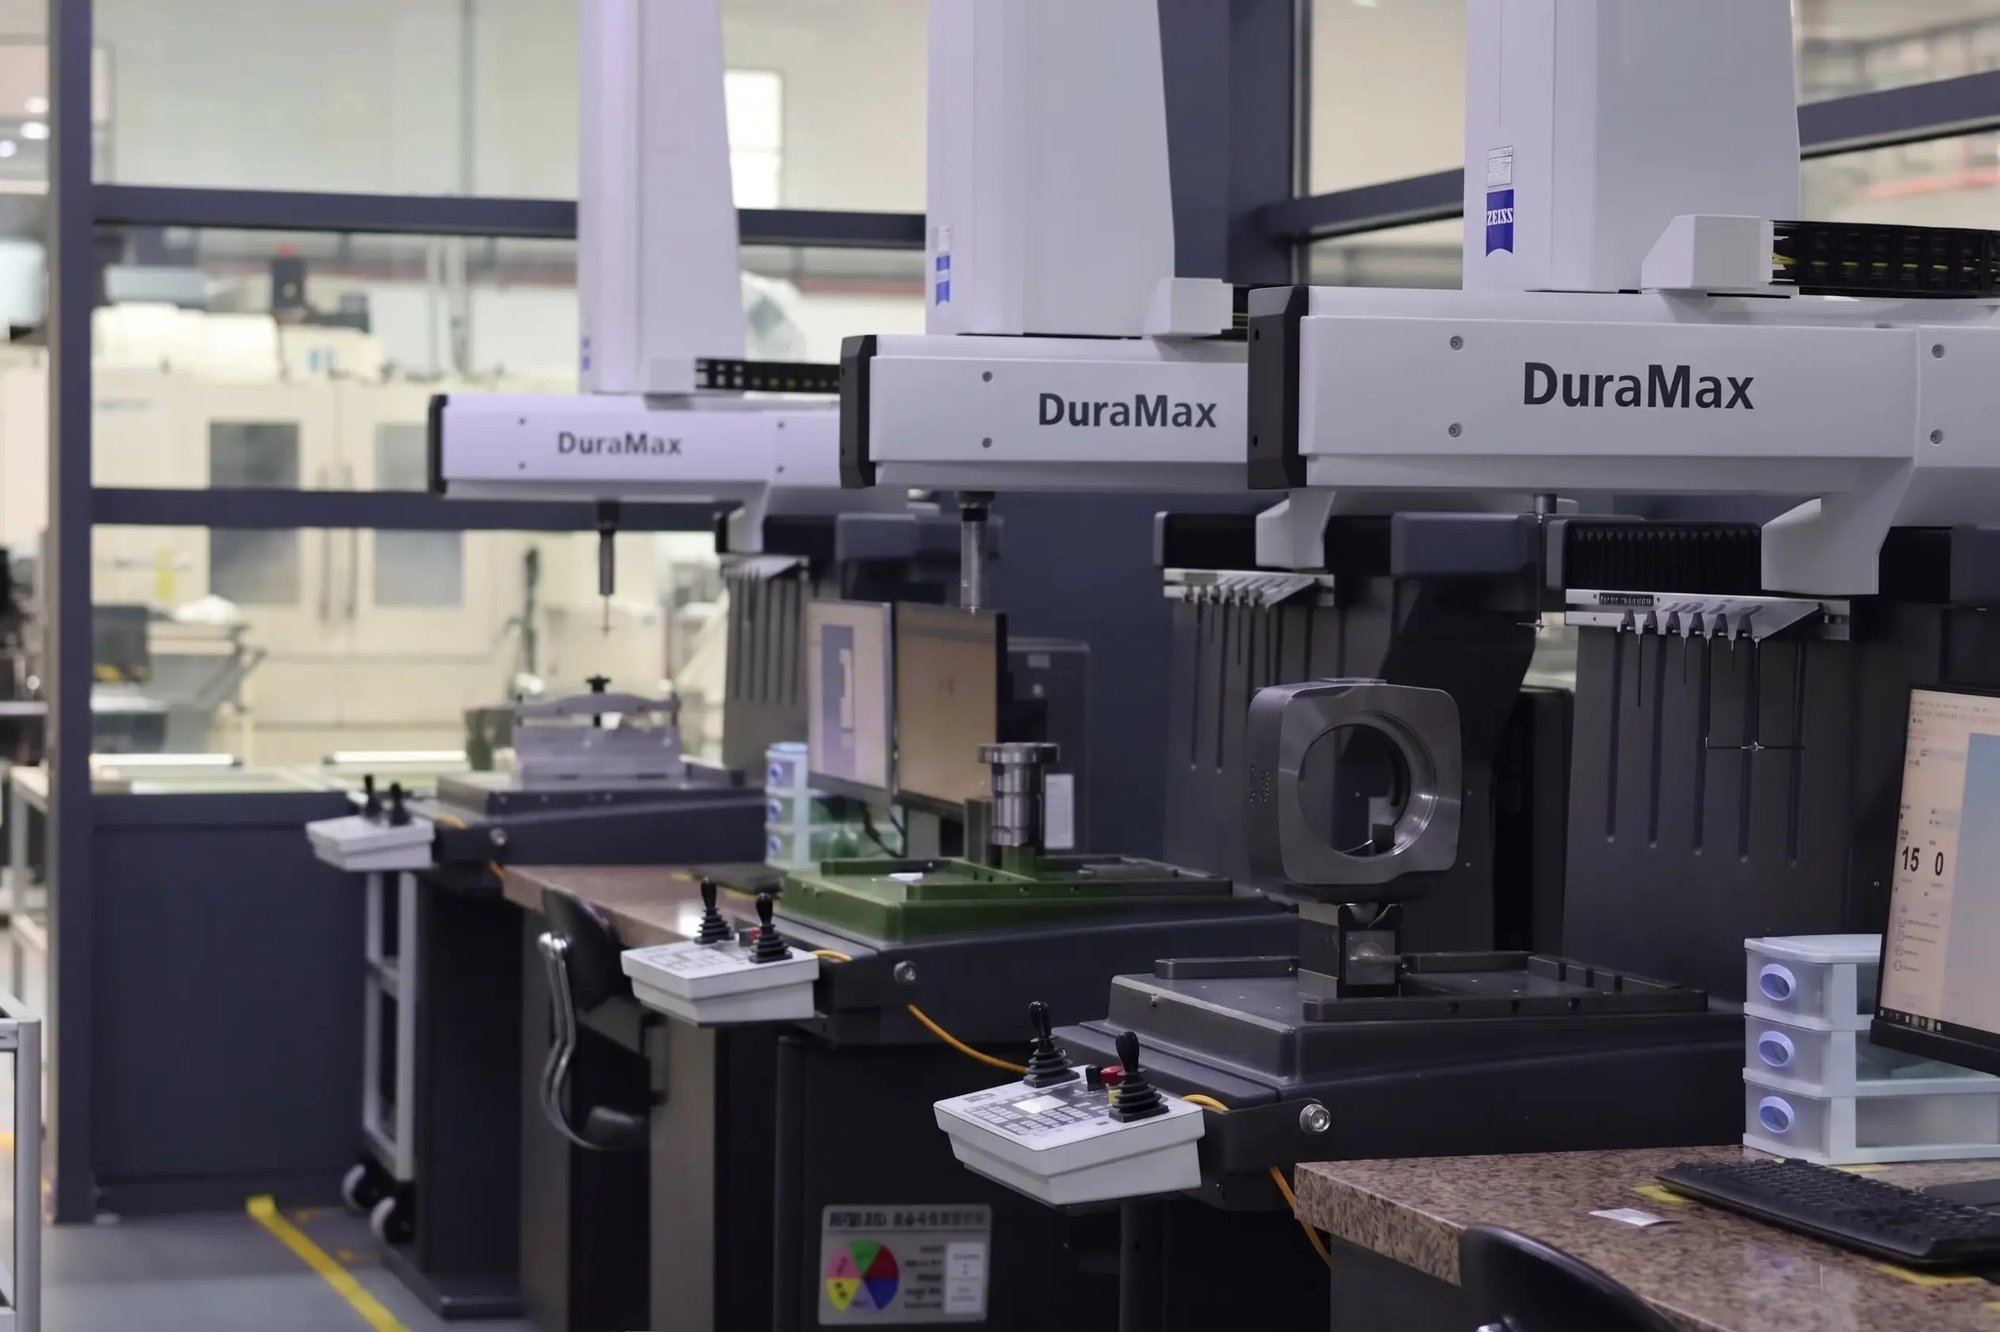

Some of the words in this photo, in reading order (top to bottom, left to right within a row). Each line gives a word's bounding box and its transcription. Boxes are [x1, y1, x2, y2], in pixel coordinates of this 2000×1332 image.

[1487, 207, 1513, 226] ZEISS
[1524, 362, 1754, 409] DuraMax
[1039, 393, 1217, 428] DuraMax
[558, 431, 682, 455] DuraMax
[1902, 845, 1920, 872] 15
[1935, 851, 1943, 876] 0
